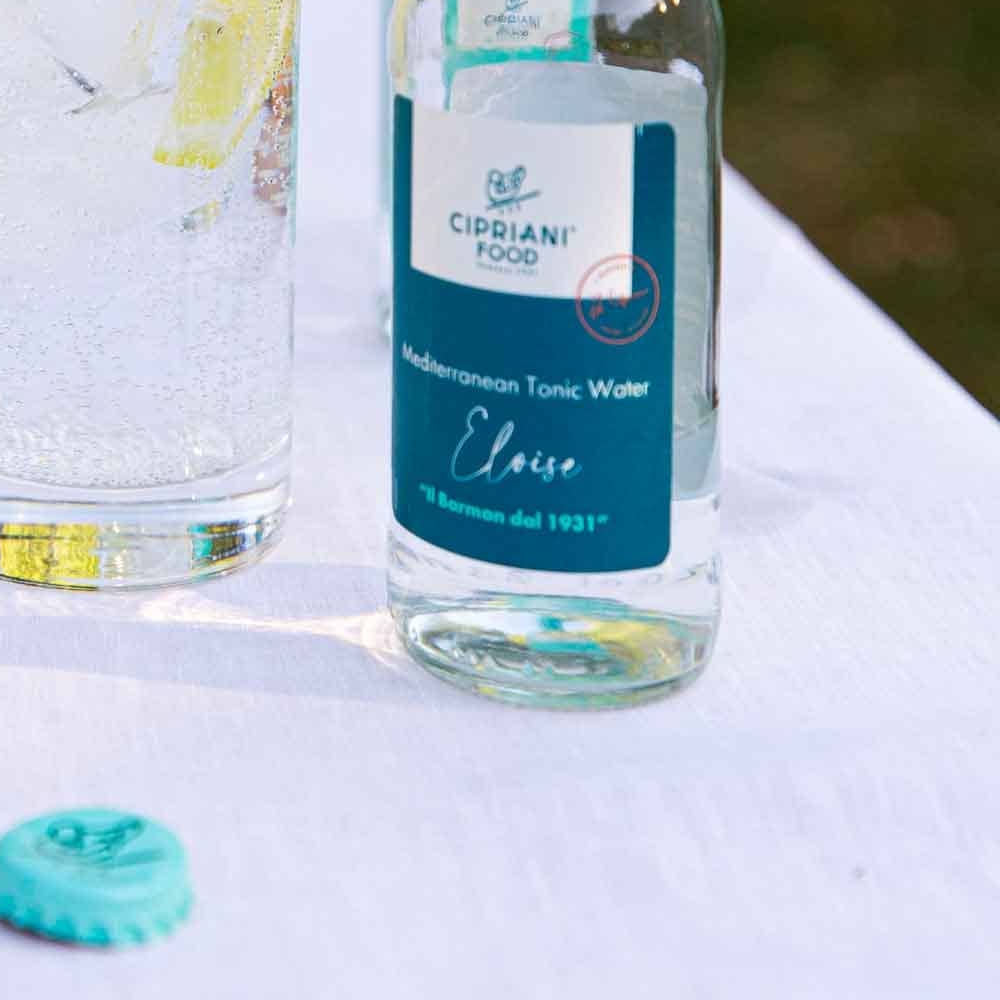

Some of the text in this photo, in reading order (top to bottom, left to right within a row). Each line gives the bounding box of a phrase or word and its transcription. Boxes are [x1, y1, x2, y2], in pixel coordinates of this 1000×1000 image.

[449, 211, 568, 247] CIPRIANI
[475, 241, 539, 266] FOOD
[401, 341, 650, 401] Mediterranean Tonic Water
[451, 405, 583, 483] Eloise
[438, 491, 505, 525] Barman
[509, 509, 542, 530] dal
